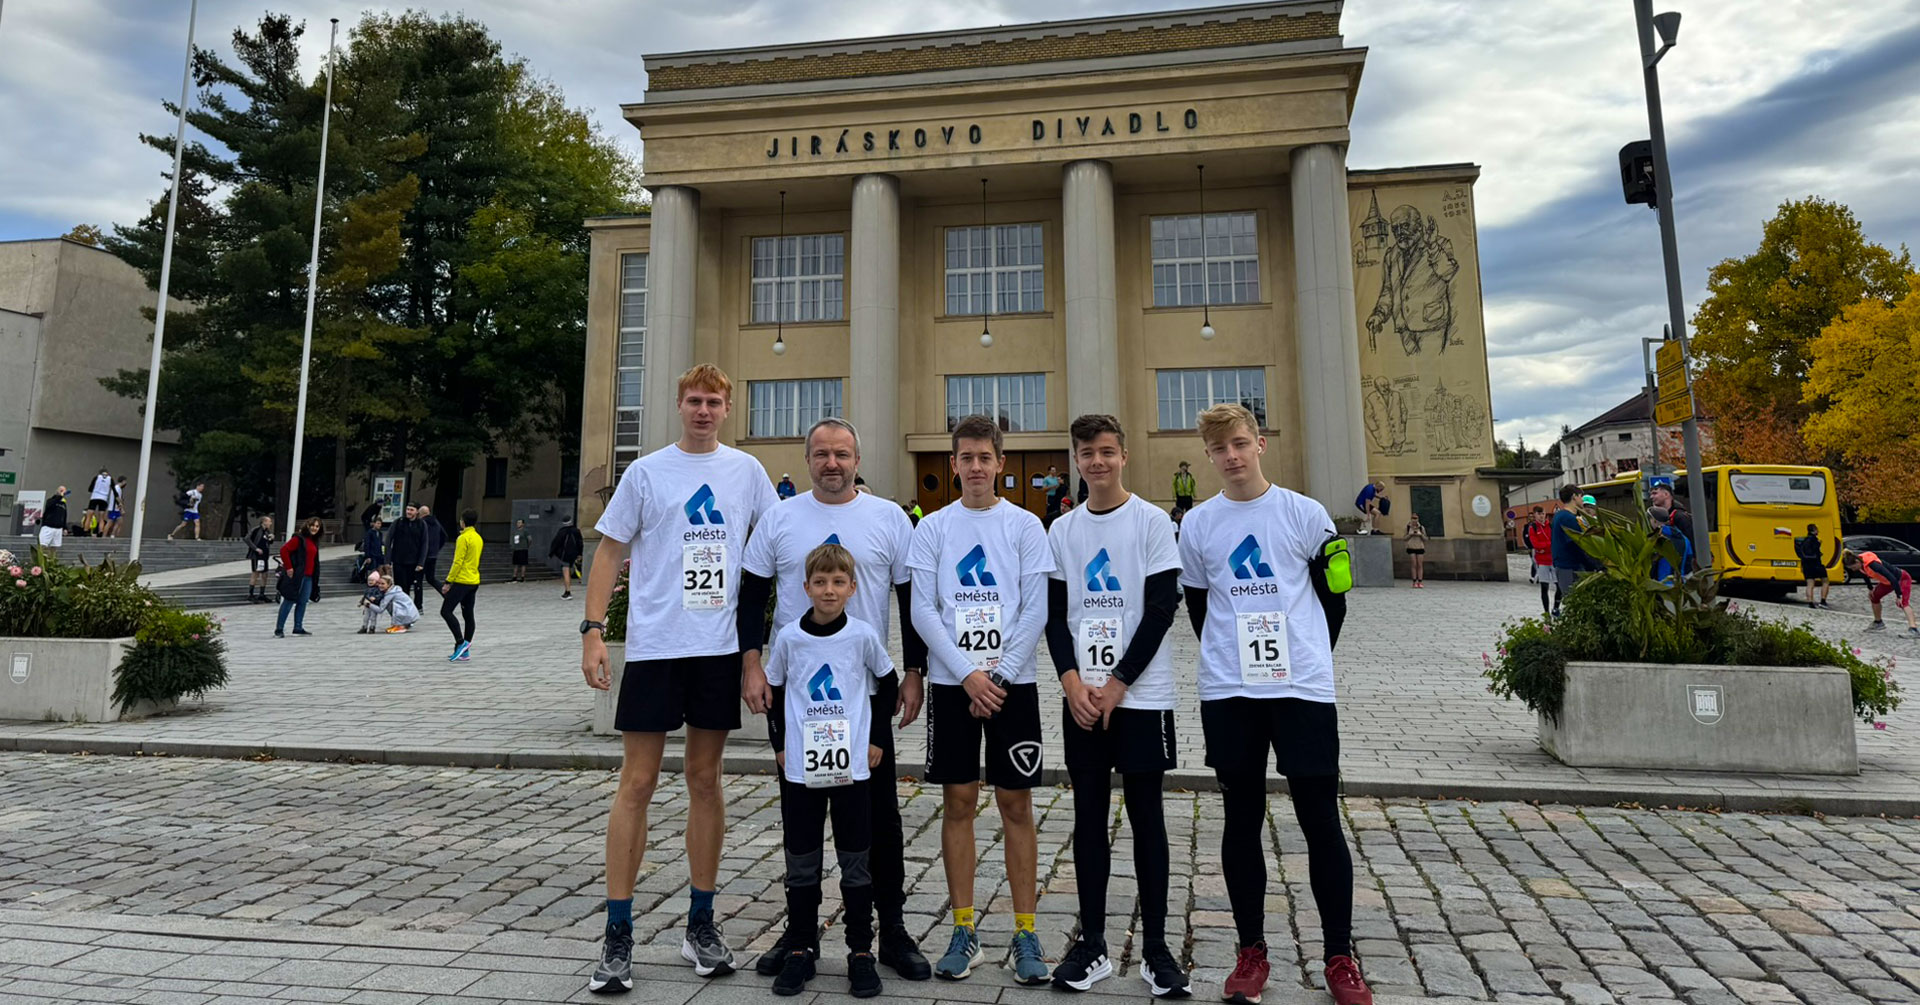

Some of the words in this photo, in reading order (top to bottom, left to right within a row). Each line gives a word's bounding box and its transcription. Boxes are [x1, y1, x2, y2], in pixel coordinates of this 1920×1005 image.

[766, 124, 982, 159] JIRÁSKOVO
[1032, 107, 1198, 141] DIVADLO
[683, 528, 727, 542] eMěsta
[684, 568, 724, 591] 321
[955, 589, 999, 602] eMěsta
[1230, 582, 1278, 597] eMěsta
[1083, 594, 1124, 608] eMěsta
[958, 629, 1002, 652] 420
[1087, 644, 1115, 667] 16
[1248, 639, 1280, 662] 15
[1271, 671, 1287, 679] CUP
[806, 704, 845, 717] eMěsta
[805, 747, 850, 772] 340
